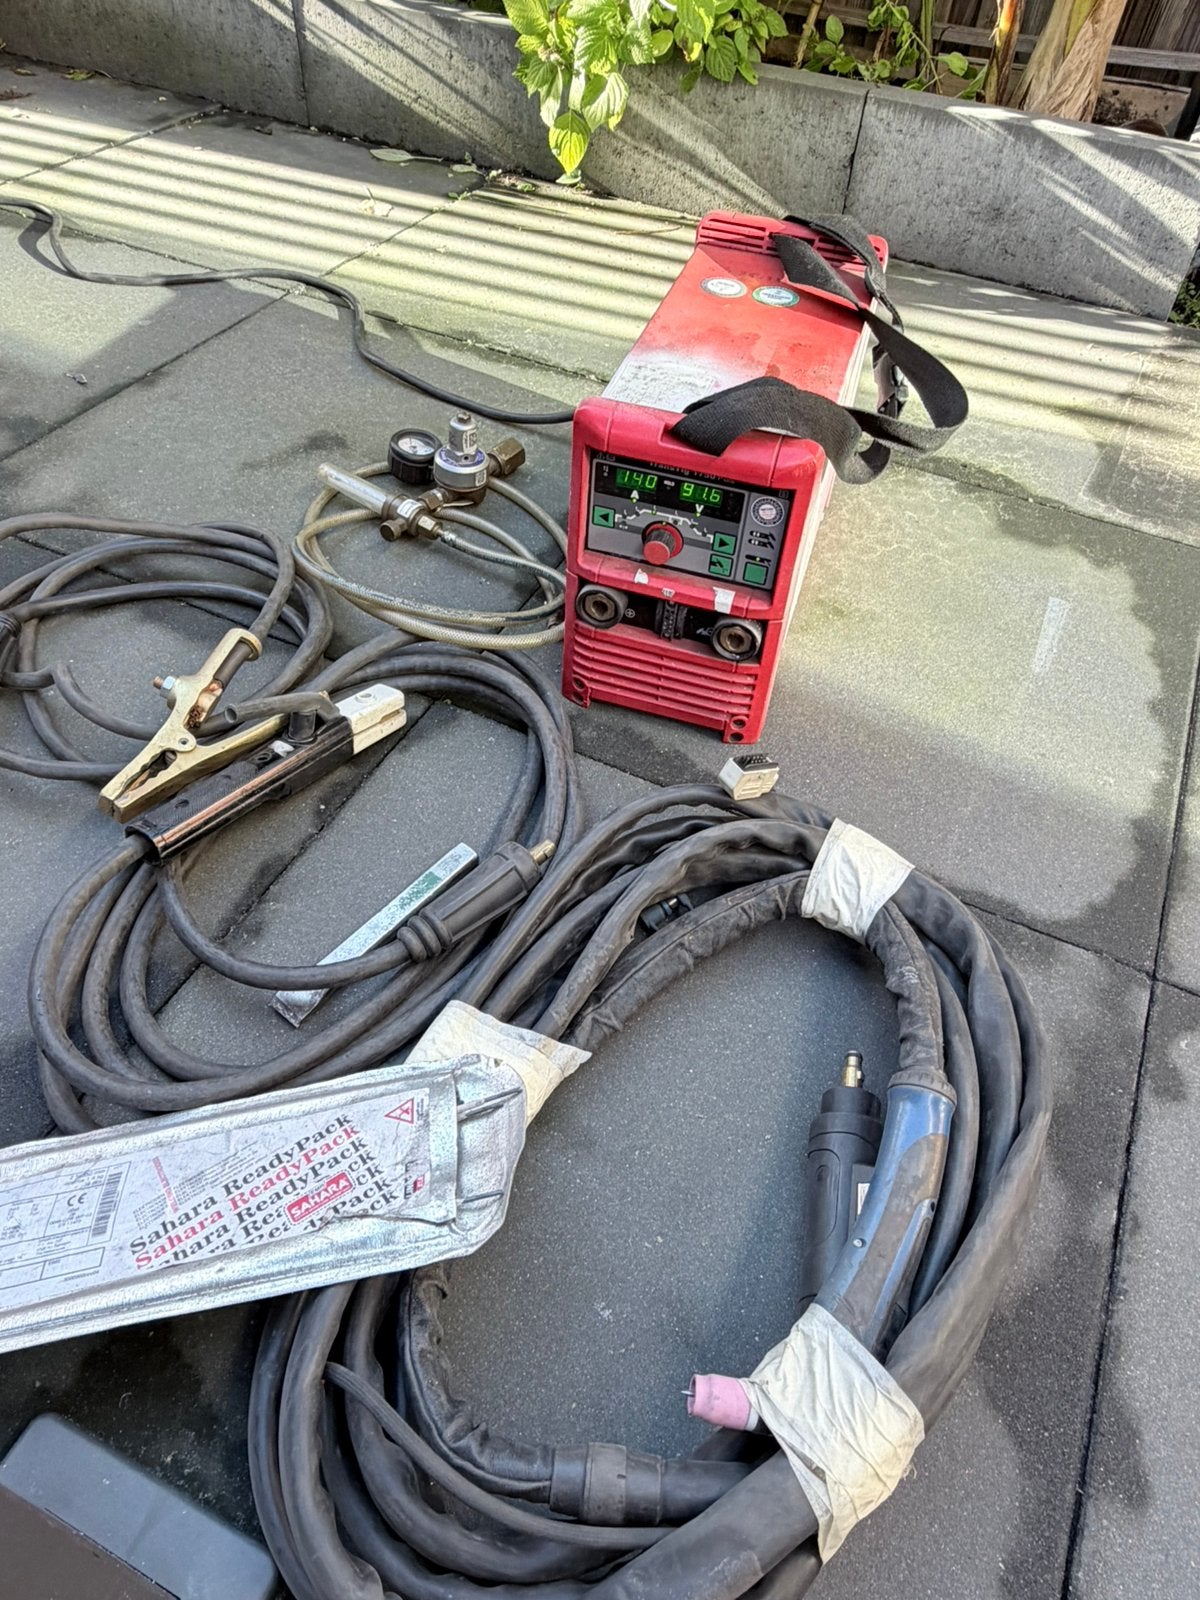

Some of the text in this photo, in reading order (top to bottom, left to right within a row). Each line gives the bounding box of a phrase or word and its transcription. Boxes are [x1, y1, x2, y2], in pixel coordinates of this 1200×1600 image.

[623, 470, 658, 489] 140
[630, 490, 640, 499] A
[695, 503, 705, 513] V
[130, 1196, 218, 1256] Sahara
[222, 1114, 353, 1197] ReadyPack
[135, 1210, 224, 1270] Sahara
[228, 1125, 360, 1212] ReadyPack
[235, 1136, 369, 1226] ReadyPack
[289, 1178, 351, 1219] SAHARA
